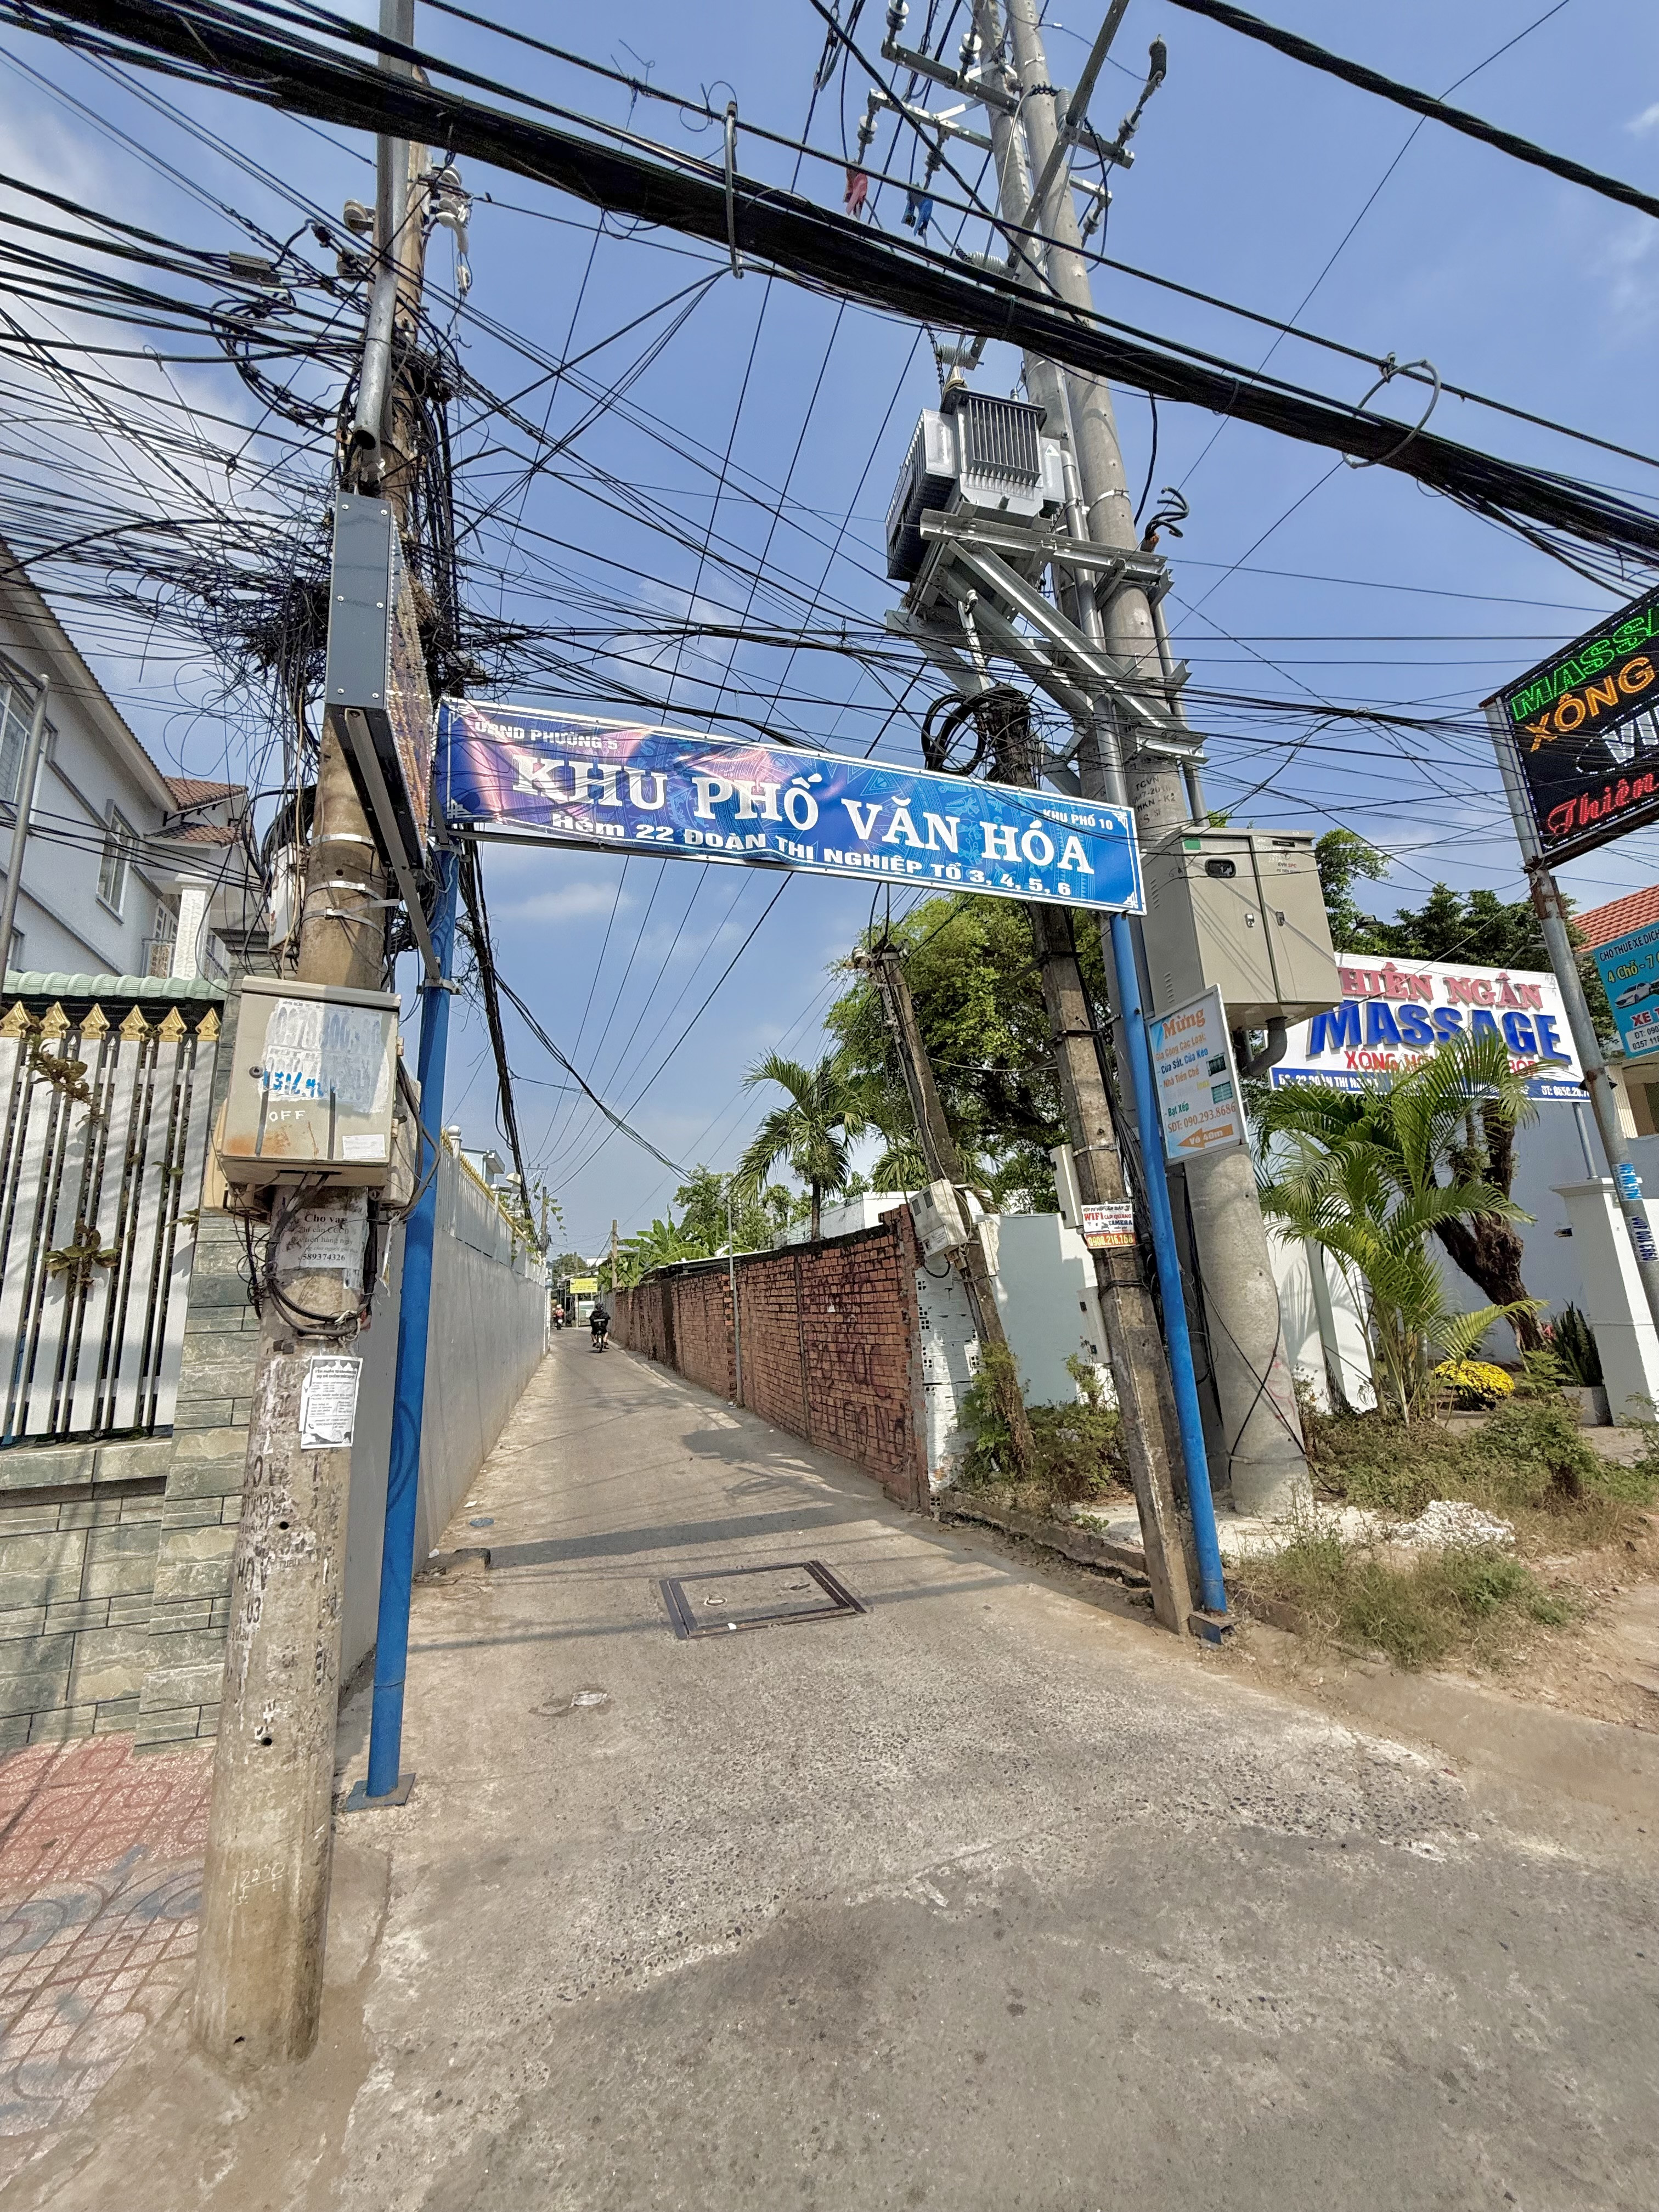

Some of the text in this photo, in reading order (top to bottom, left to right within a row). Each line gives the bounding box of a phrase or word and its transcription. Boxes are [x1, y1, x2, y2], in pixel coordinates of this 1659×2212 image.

[1525, 656, 1656, 753] XÔNG
[607, 737, 618, 751] 5
[1602, 704, 1659, 764] VI
[512, 754, 1094, 874] KHU PHỐ VĂN HÓA
[1071, 813, 1096, 828] PHỐ
[1099, 818, 1113, 831] 10
[636, 823, 673, 842] 22
[774, 836, 814, 862] THỊ
[824, 849, 922, 875] NGHIỆP
[930, 860, 961, 881] TỔ
[969, 871, 991, 886] 3,
[1000, 875, 1020, 891] 4,
[1029, 879, 1049, 895] 5,
[1058, 883, 1071, 896] 6
[1600, 950, 1614, 962] CHO
[1633, 936, 1644, 948] XE
[1608, 970, 1616, 983] 4
[1645, 954, 1654, 969] 7
[1338, 962, 1542, 1009] HIÊN NGÂN
[1163, 1008, 1206, 1039] Mừng
[1631, 1011, 1652, 1027] XE
[1647, 1025, 1659, 1035] 090
[1308, 1000, 1572, 1065] MASSAGE
[269, 1110, 305, 1121] OFF
[1184, 1101, 1237, 1127] 090.293.8686
[304, 1213, 326, 1223] Cho
[1084, 1212, 1104, 1221] WIFI
